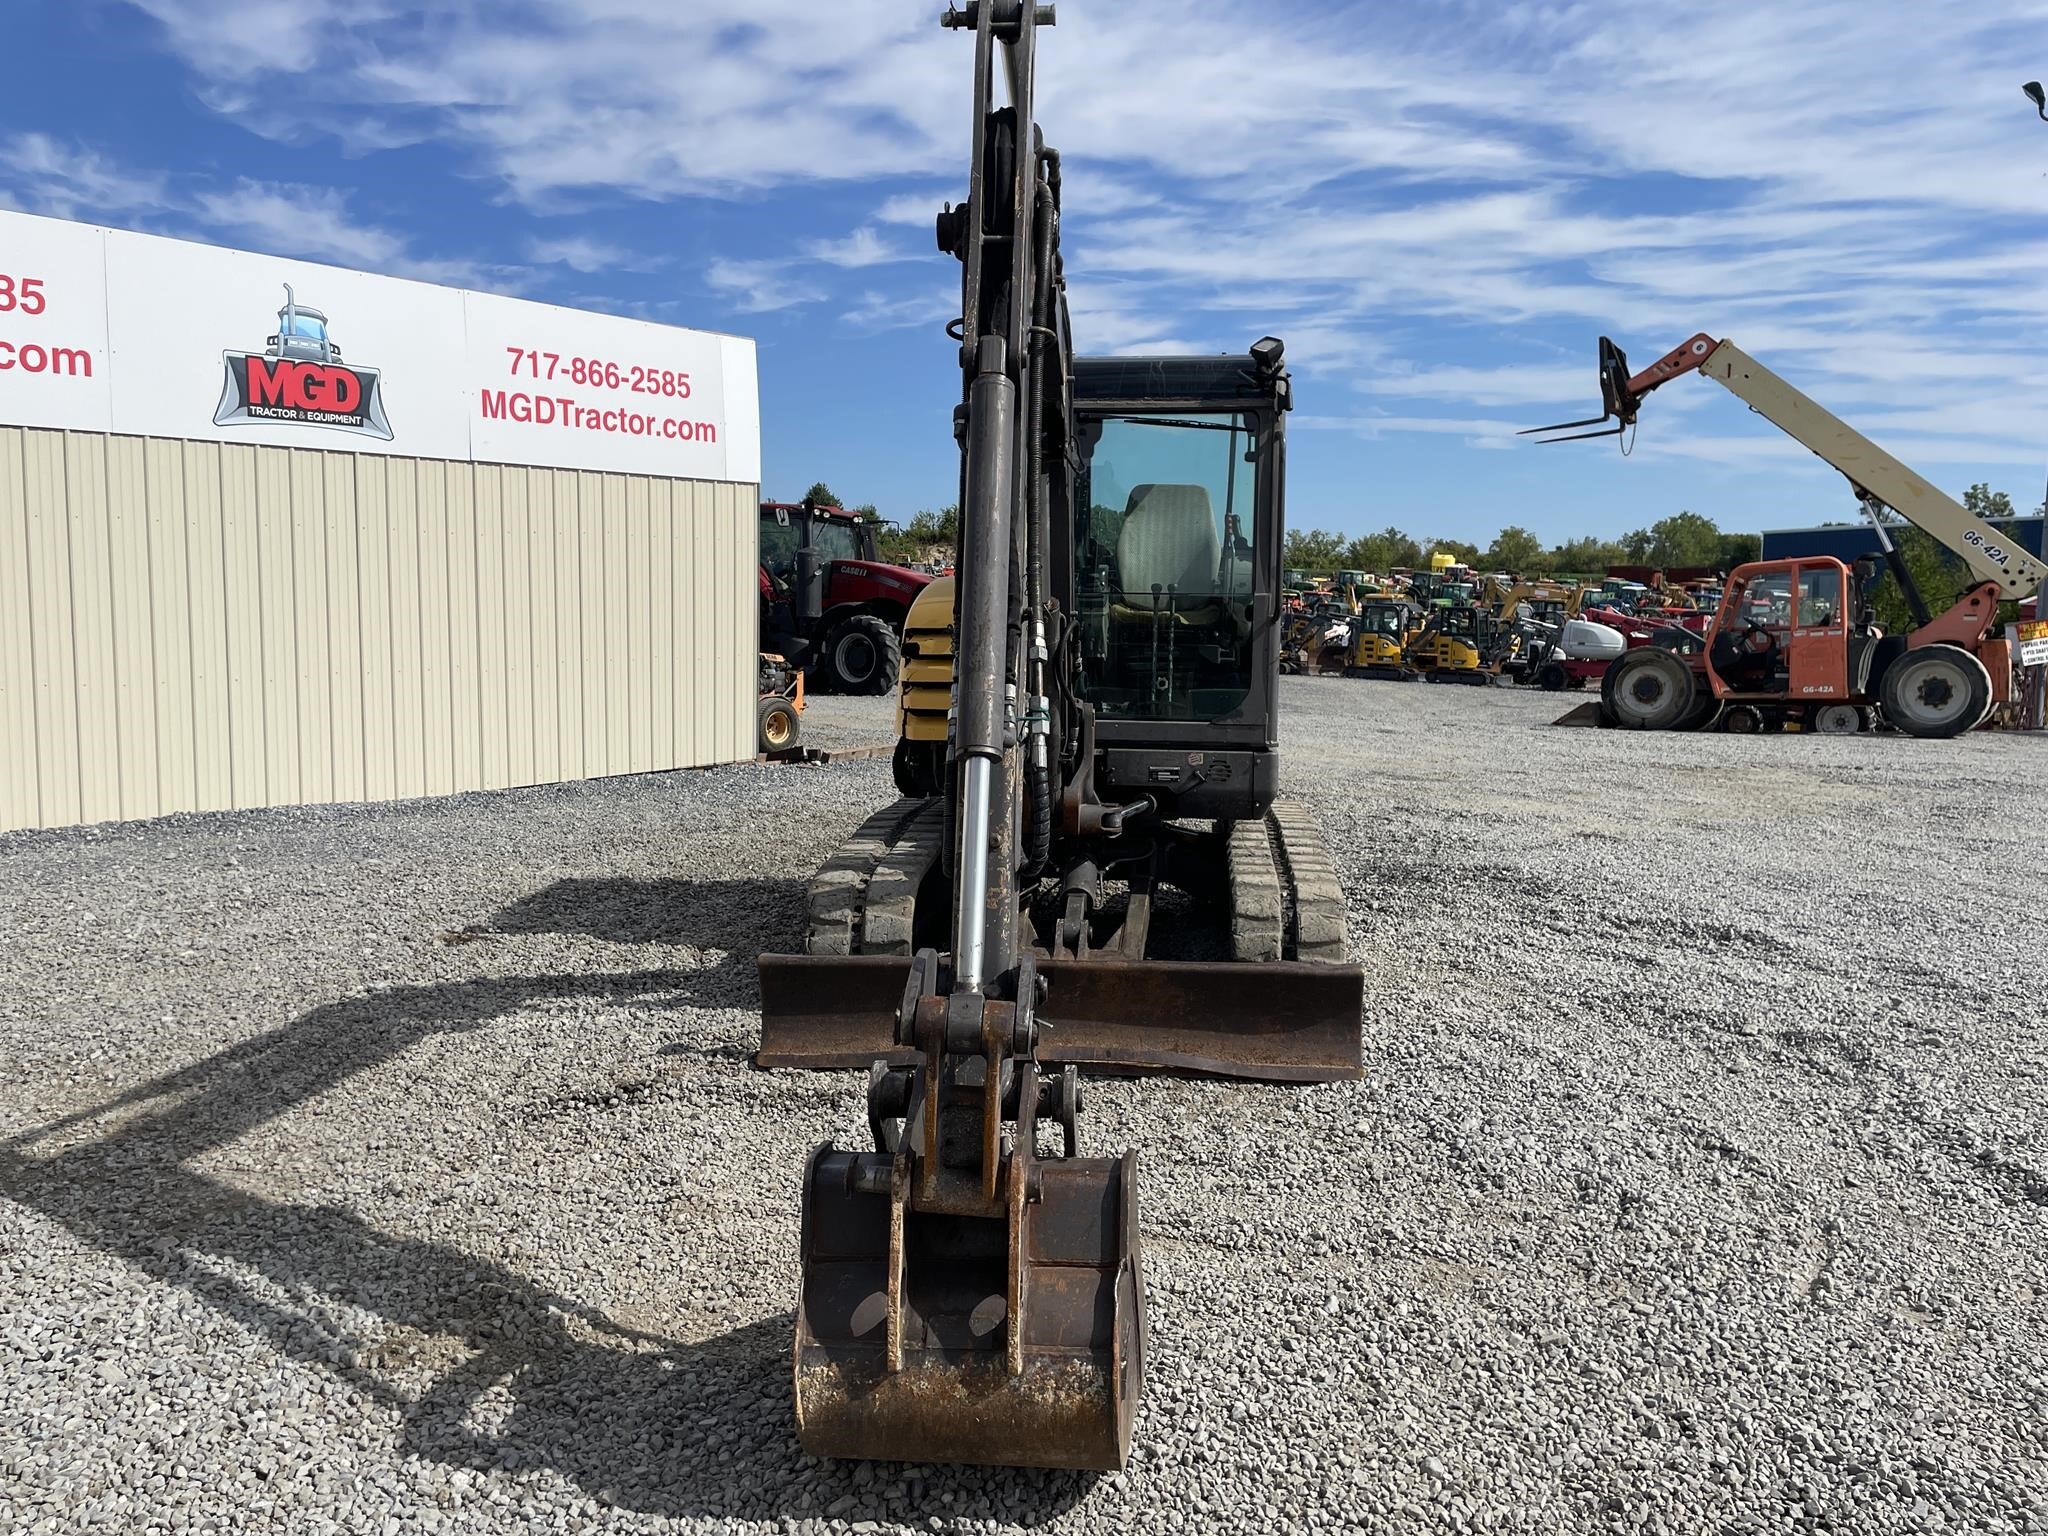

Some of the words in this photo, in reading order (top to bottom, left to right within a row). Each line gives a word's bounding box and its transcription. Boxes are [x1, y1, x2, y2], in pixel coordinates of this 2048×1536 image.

[0, 274, 46, 315] 85
[246, 356, 361, 412] MGD
[507, 347, 691, 399] 717-866-2585
[250, 406, 297, 419] TRACTOR
[298, 410, 306, 419] &
[307, 412, 361, 424] EQUIPMENT
[481, 389, 716, 443] MGDTractor.com
[1963, 531, 2009, 566] G6-42A
